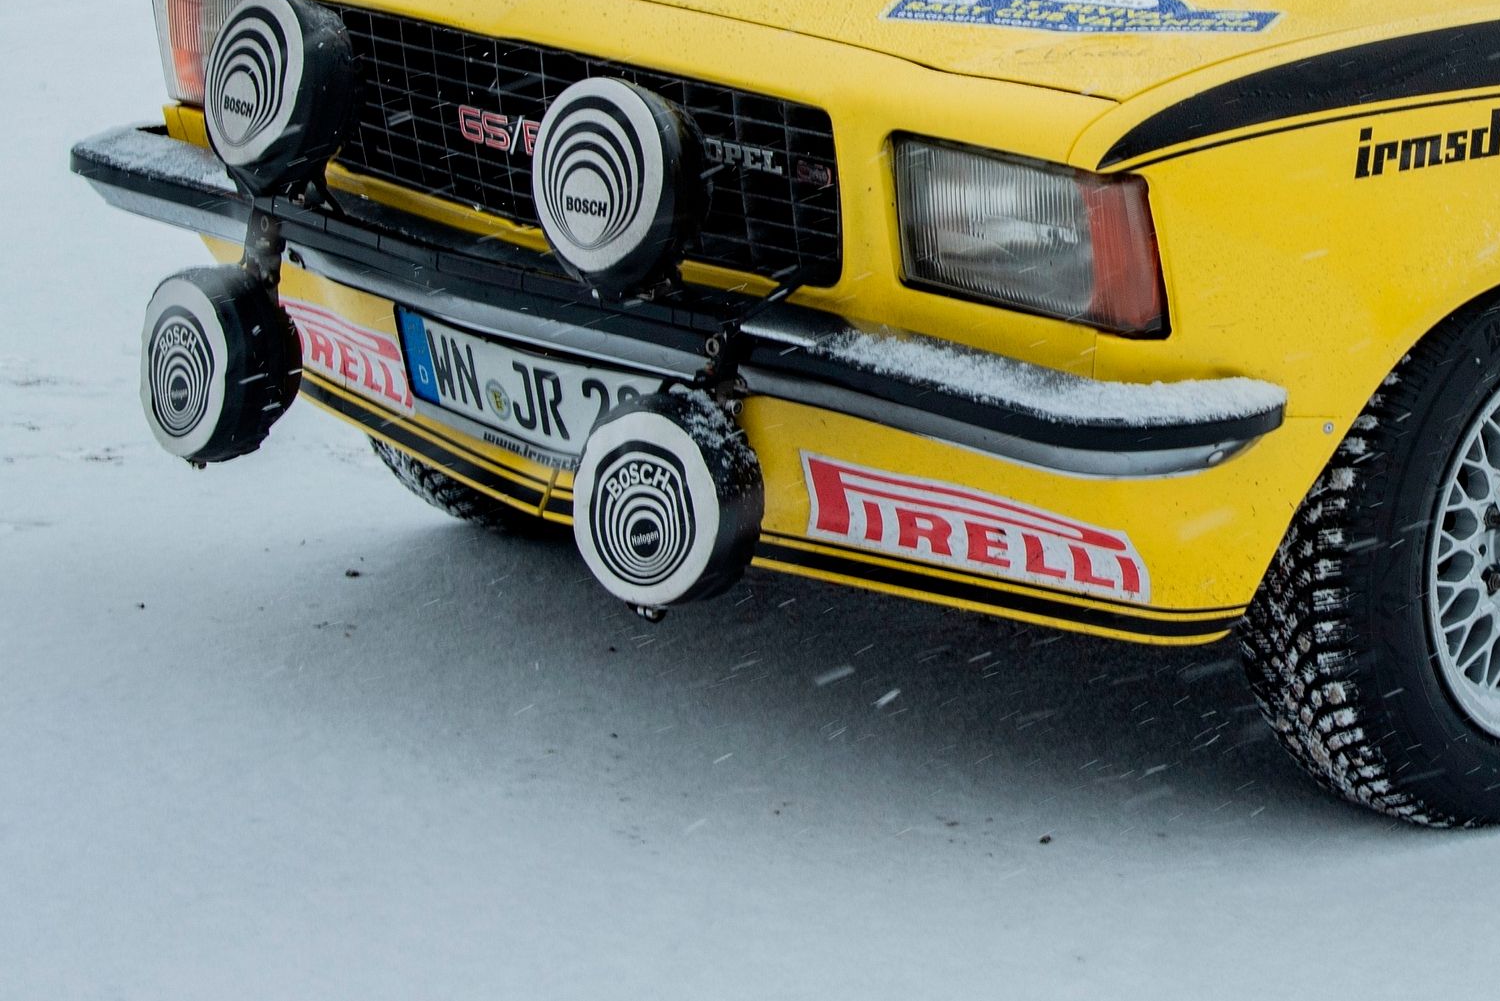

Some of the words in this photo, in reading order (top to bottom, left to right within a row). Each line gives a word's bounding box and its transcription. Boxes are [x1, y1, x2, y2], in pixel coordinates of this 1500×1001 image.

[904, 1, 992, 16] RALLY
[223, 94, 254, 118] BOSCH
[566, 195, 608, 218] BOSCH
[159, 324, 197, 357] BOSCH
[287, 302, 413, 408] RELLI
[419, 367, 429, 385] D
[425, 328, 483, 411] WN
[512, 360, 570, 440] JR
[605, 462, 671, 501] BOSCH
[631, 530, 660, 547] Halogen
[807, 456, 1140, 593] PIRELLI
